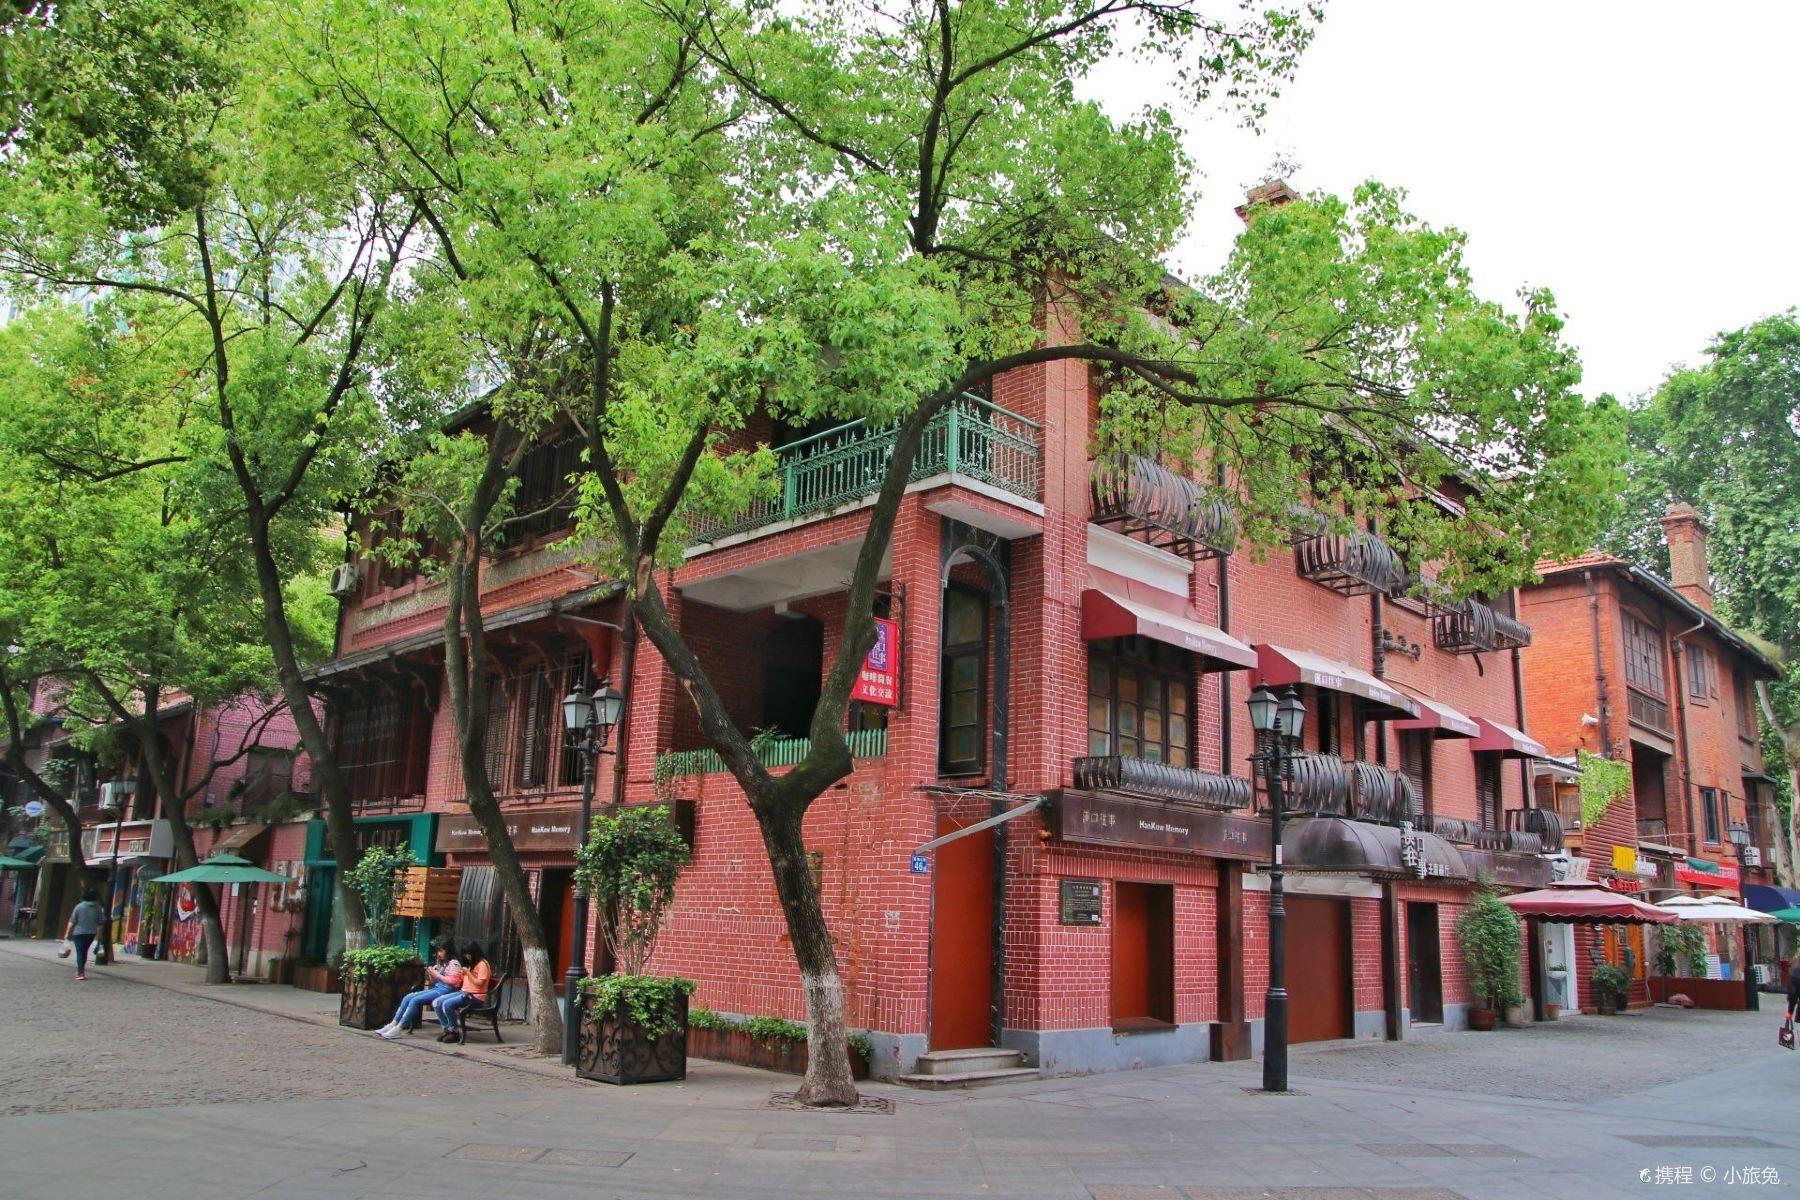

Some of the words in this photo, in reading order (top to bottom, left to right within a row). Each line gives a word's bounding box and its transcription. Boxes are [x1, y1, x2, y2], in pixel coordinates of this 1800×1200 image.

[862, 684, 893, 700] 文化交流
[531, 826, 550, 834] HanKow
[551, 825, 571, 835] Memory
[1139, 820, 1164, 832] HanKow
[1165, 824, 1189, 836] Memory
